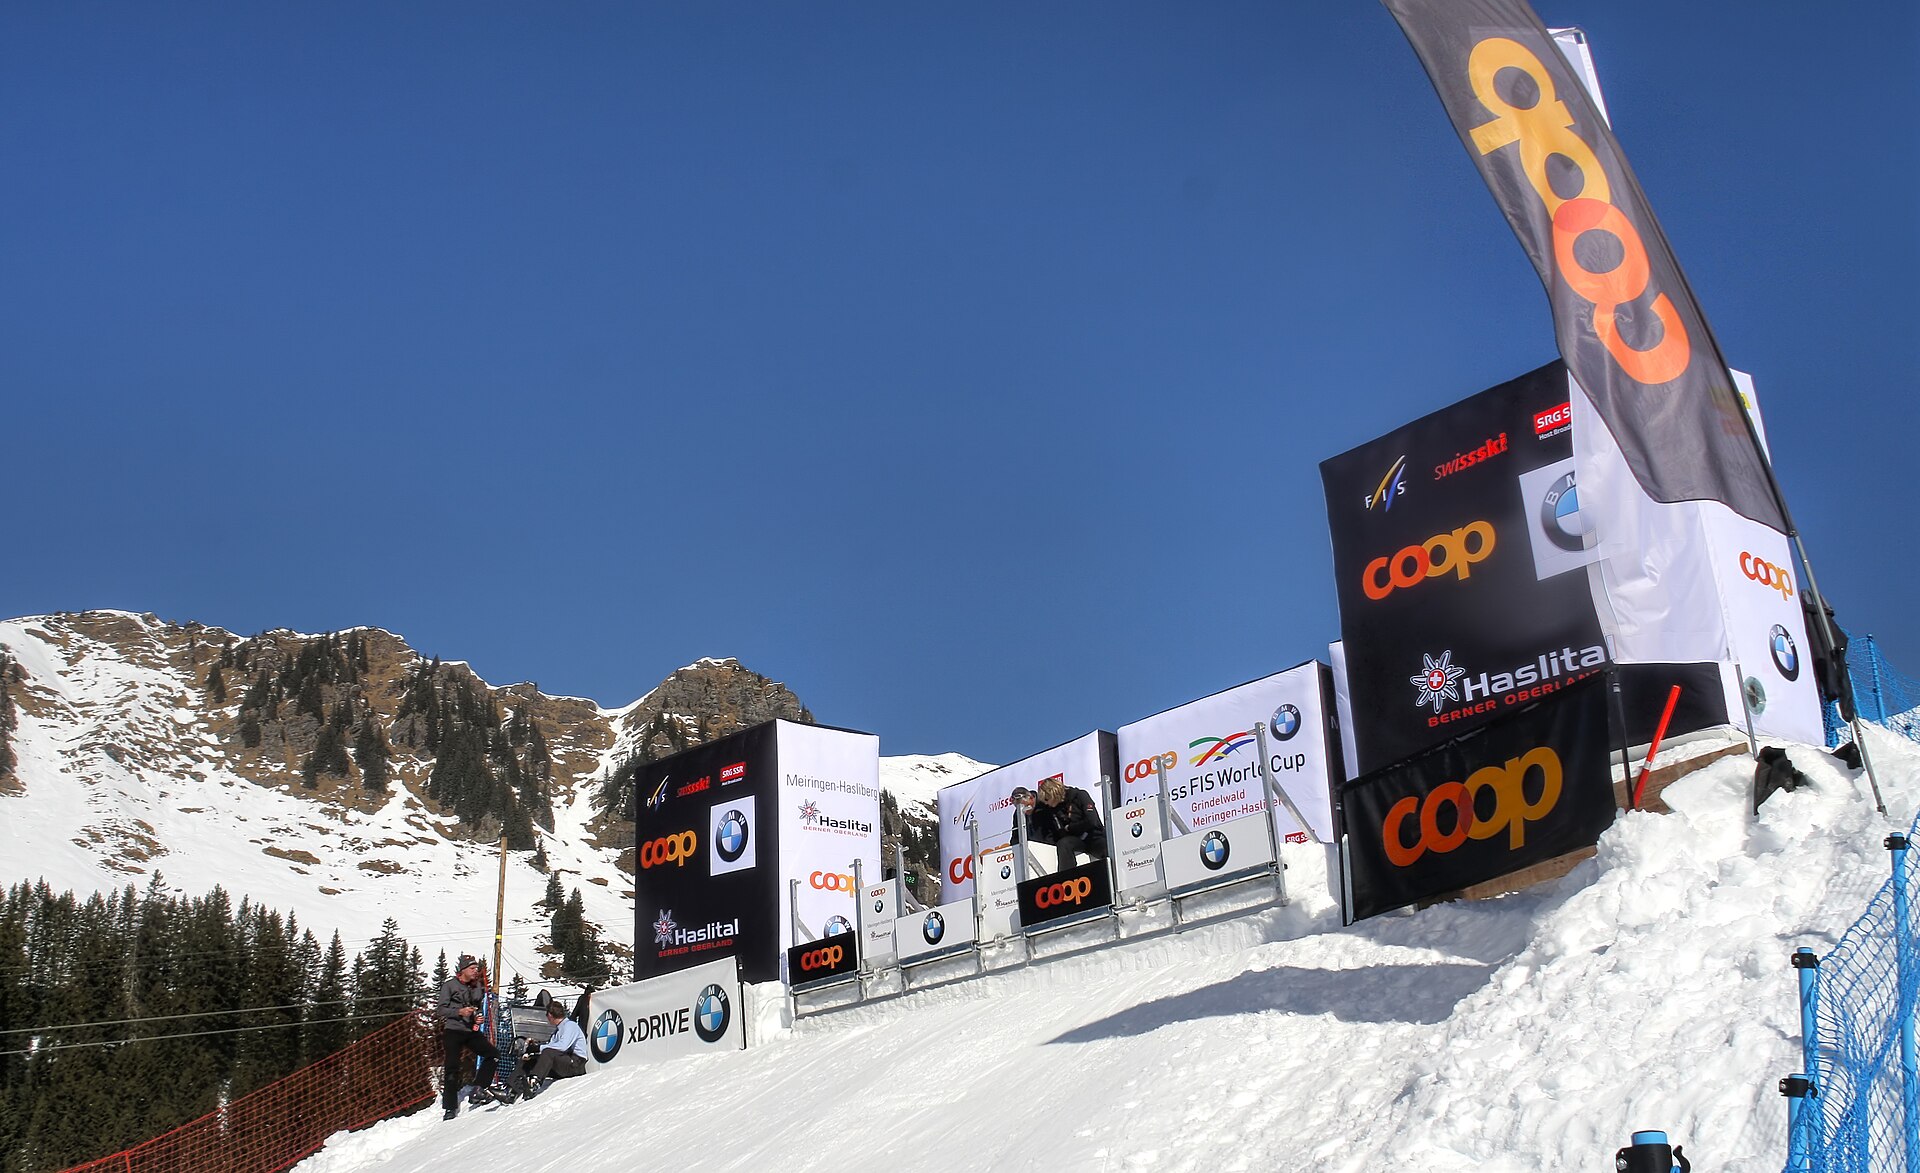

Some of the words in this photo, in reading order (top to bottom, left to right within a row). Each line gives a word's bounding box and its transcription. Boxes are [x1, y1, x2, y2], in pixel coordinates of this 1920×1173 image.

[1537, 411, 1561, 429] SRG
[1539, 430, 1553, 440] Host
[1434, 432, 1509, 481] swissski
[1365, 481, 1406, 508] FIS
[1362, 520, 1496, 600] coop
[1739, 551, 1793, 601] coop
[1428, 699, 1497, 728] BERNER
[786, 773, 878, 801] Meiringen-Hasliberg
[1190, 773, 1215, 796] FIS
[1270, 753, 1306, 773] Cup
[1125, 808, 1145, 820] coop
[1191, 789, 1246, 813] Grindelwald
[1383, 746, 1563, 867] coop
[820, 816, 872, 833] Haslital
[834, 829, 868, 838] OBERLAND
[640, 830, 697, 868] coop
[996, 853, 1014, 863] coop
[871, 887, 886, 897] coop
[1035, 876, 1091, 908] coop
[675, 918, 739, 945] Haslital
[658, 947, 689, 957] BERNER
[691, 938, 733, 952] OBERLAND
[801, 945, 843, 971] coop
[627, 1007, 690, 1044] xDRIVE
